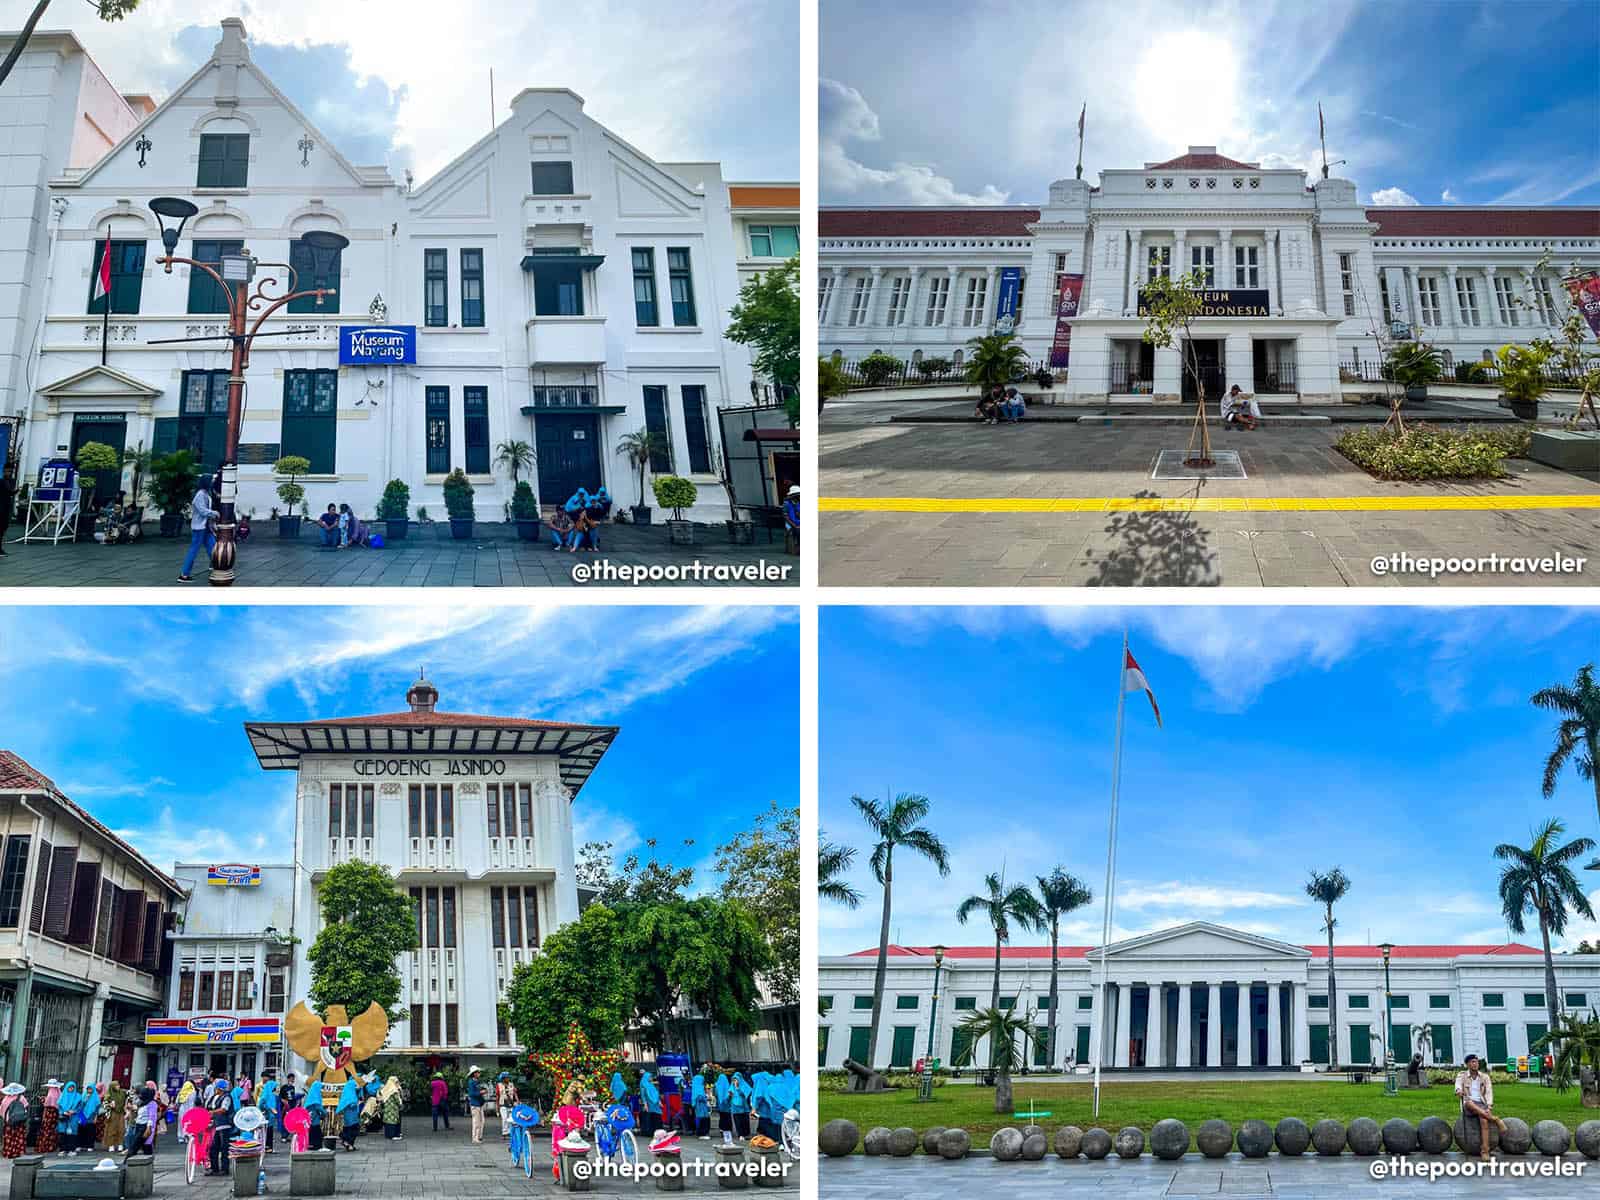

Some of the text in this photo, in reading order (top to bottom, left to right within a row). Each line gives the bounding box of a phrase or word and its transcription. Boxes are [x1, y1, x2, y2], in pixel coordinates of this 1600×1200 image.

[351, 334, 404, 346] Museum
[351, 345, 404, 360] Wayang
[353, 759, 506, 776] GEDOENG JASINDO
[228, 875, 250, 885] Point
[191, 1020, 235, 1029] Indomaret
[208, 1032, 234, 1041] Point
